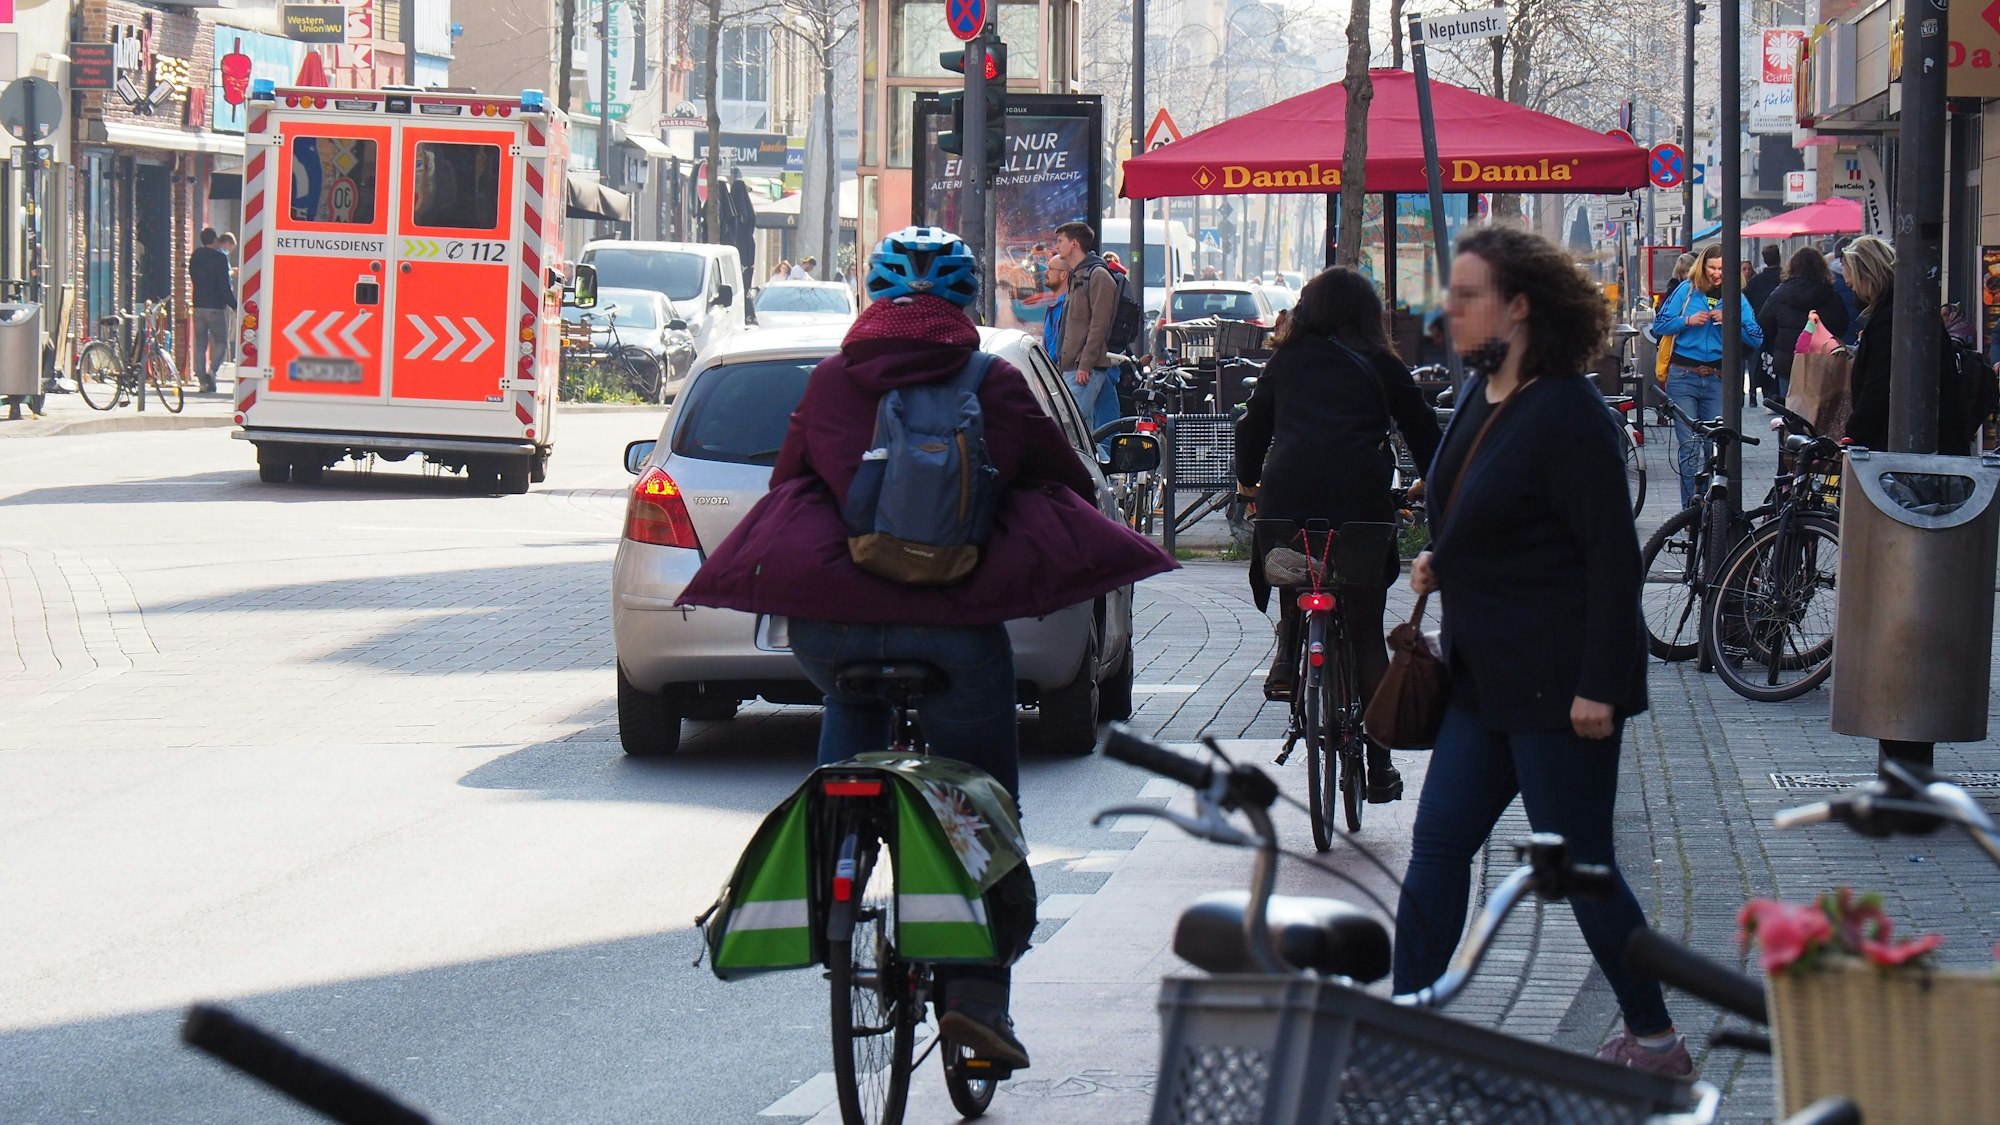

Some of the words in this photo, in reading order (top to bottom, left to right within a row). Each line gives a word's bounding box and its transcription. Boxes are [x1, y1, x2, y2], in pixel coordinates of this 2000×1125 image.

[287, 16, 324, 25] Western
[1429, 17, 1501, 40] Neptunstr.
[1947, 41, 2000, 68] Da
[1013, 132, 1058, 152] NUR
[1025, 151, 1068, 171] LIVE
[1452, 158, 1572, 182] Damla
[931, 181, 952, 190] ALTE
[1012, 174, 1032, 185] NEU
[1223, 163, 1341, 189] Damla
[277, 237, 384, 252] RETTUNGSDIENST
[471, 242, 506, 262] 112
[693, 497, 730, 505] TOYOTA
